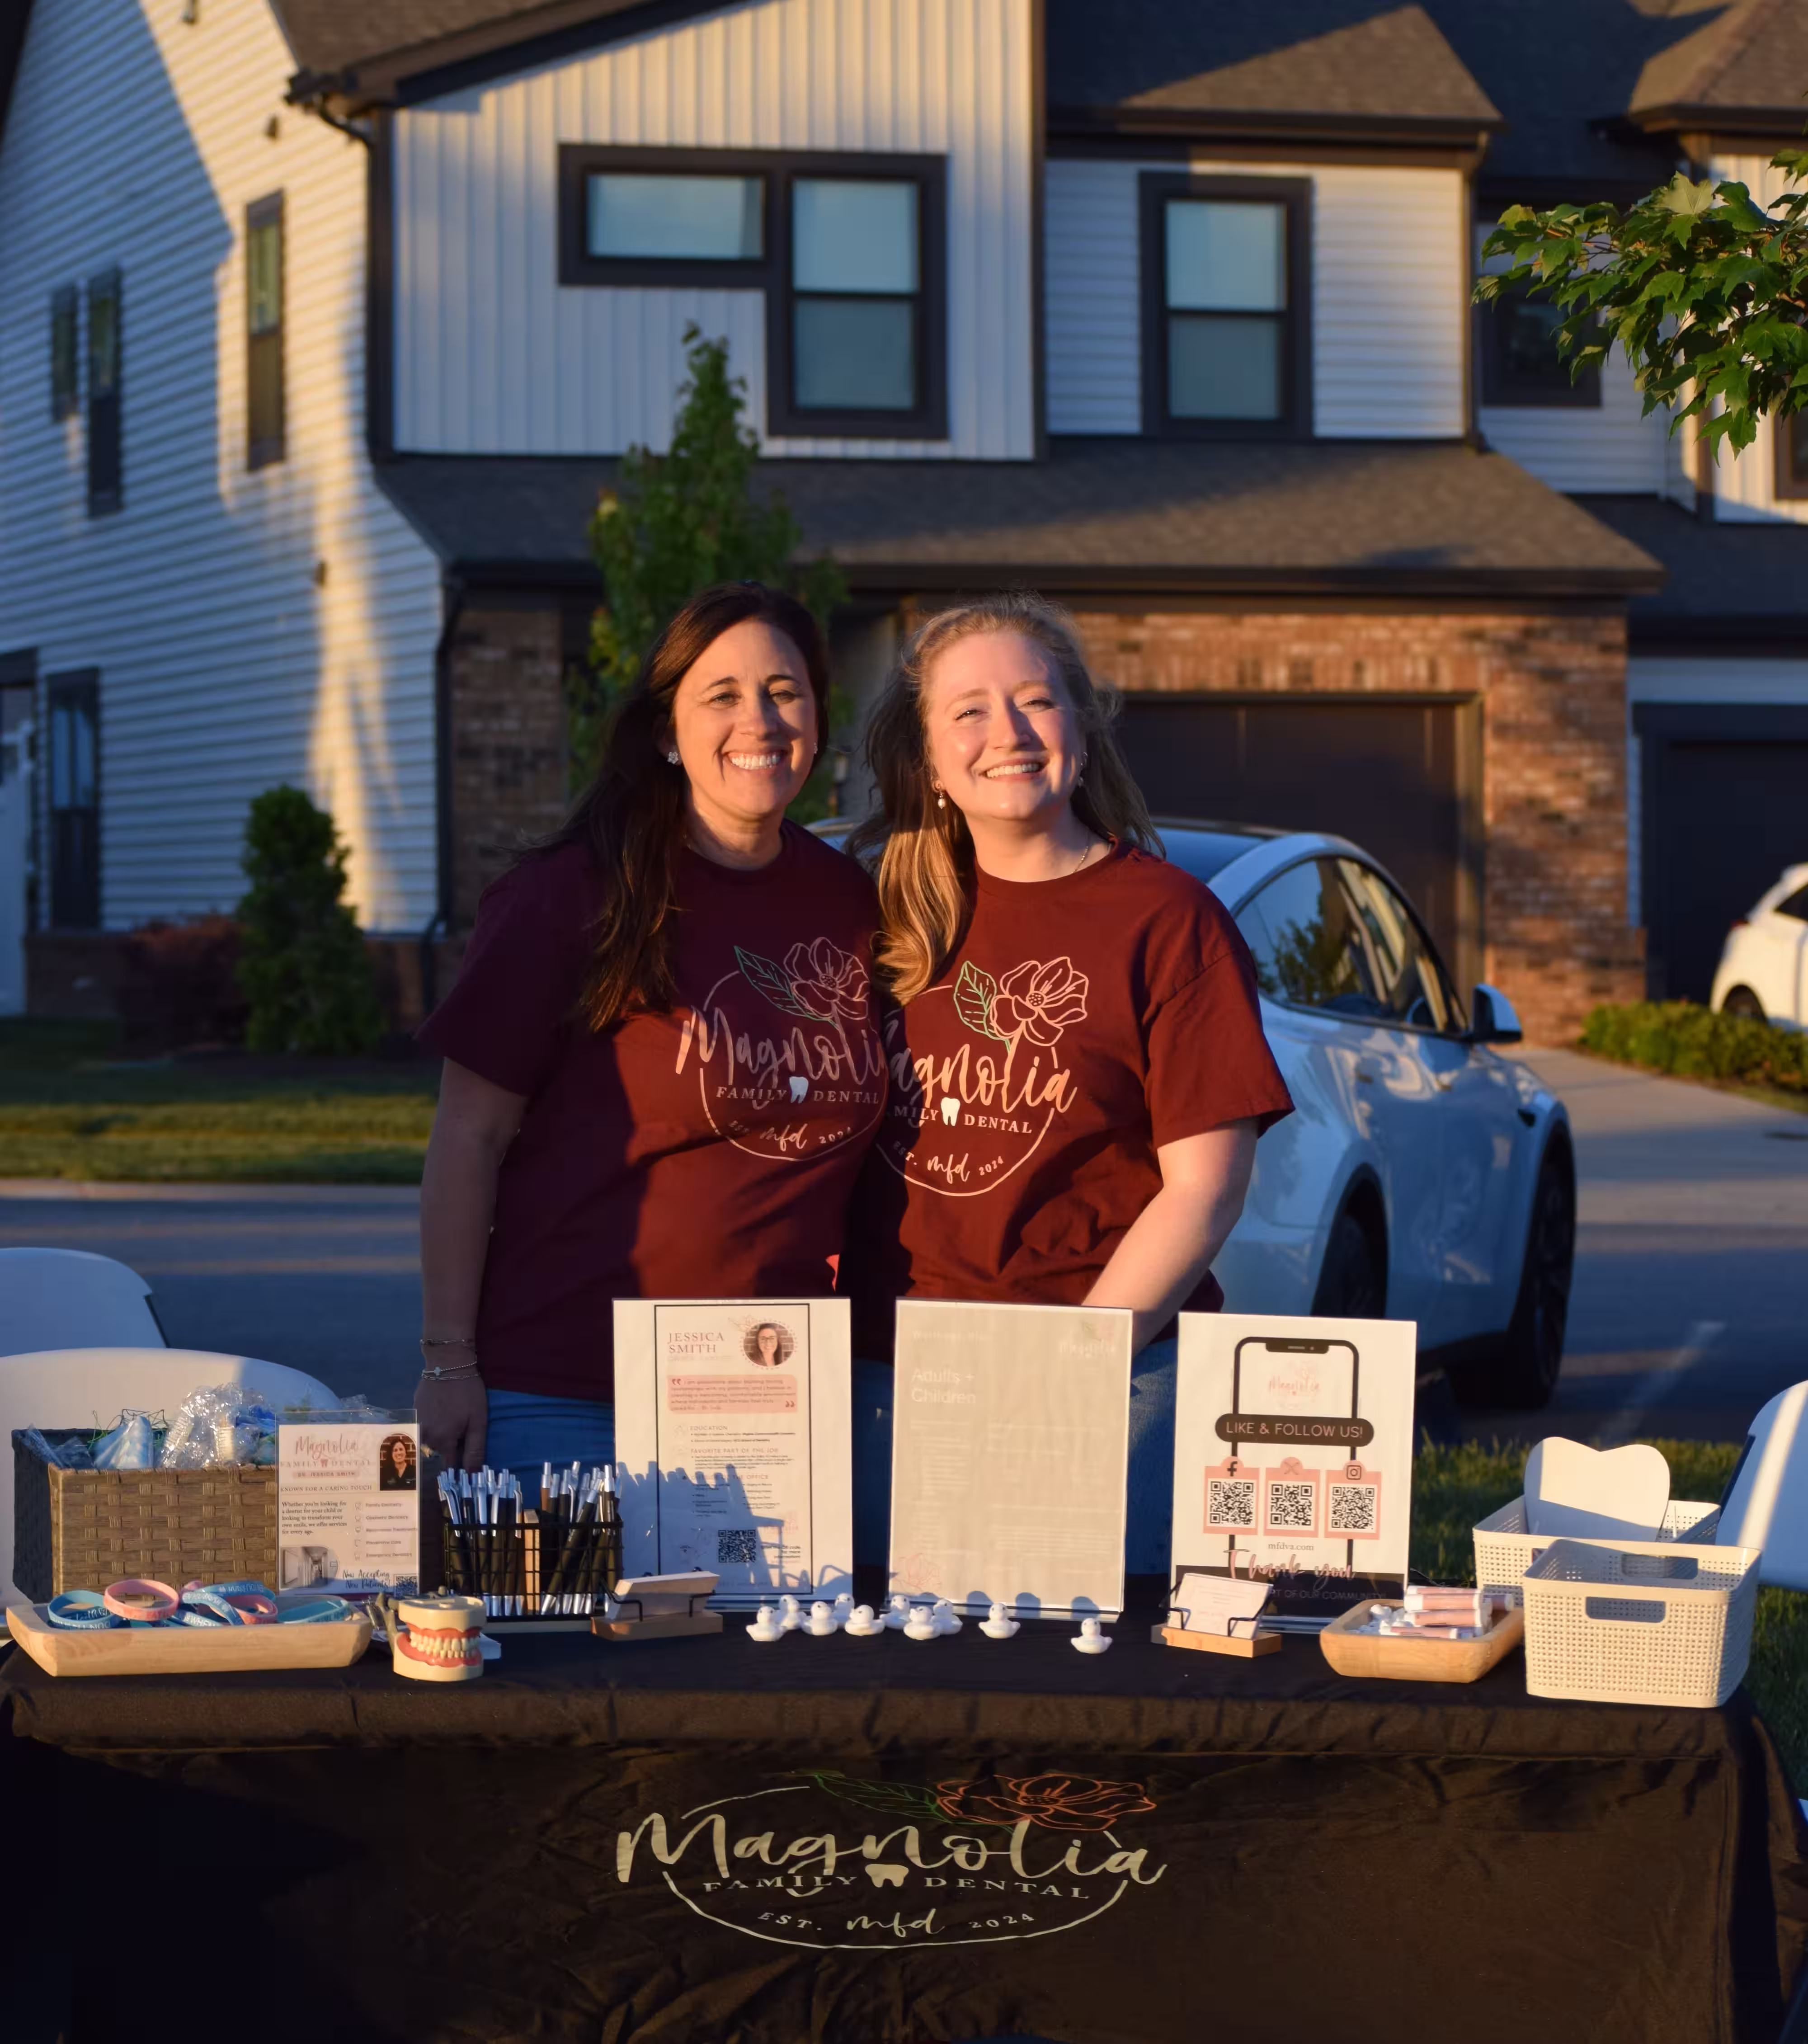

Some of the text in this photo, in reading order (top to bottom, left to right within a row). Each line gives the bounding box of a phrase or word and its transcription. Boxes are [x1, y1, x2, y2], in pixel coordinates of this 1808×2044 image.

[716, 1086, 878, 1104] FAMILY DENTAL
[894, 1105, 1032, 1134] MILY DENTAL
[760, 1124, 808, 1151] mfd
[893, 1140, 1004, 1184] EST. mfd 2024
[668, 1332, 724, 1344] JESSICA
[669, 1344, 716, 1353] SMITH
[911, 1368, 960, 1384] Adults
[911, 1388, 976, 1403] Children
[1226, 1422, 1363, 1438] LIKE & FOLLOW US!
[295, 1433, 358, 1460] Magnolia
[1268, 1542, 1314, 1551] mfdva.com
[358, 1569, 390, 1581] Accepting
[1223, 1549, 1356, 1592] Thank you
[1299, 1590, 1319, 1599] OUR
[616, 1812, 1168, 1898] Magnolia
[703, 1874, 1090, 1900] FAMILY DENTAL
[757, 1907, 1037, 1938] EST. mfd 2024
